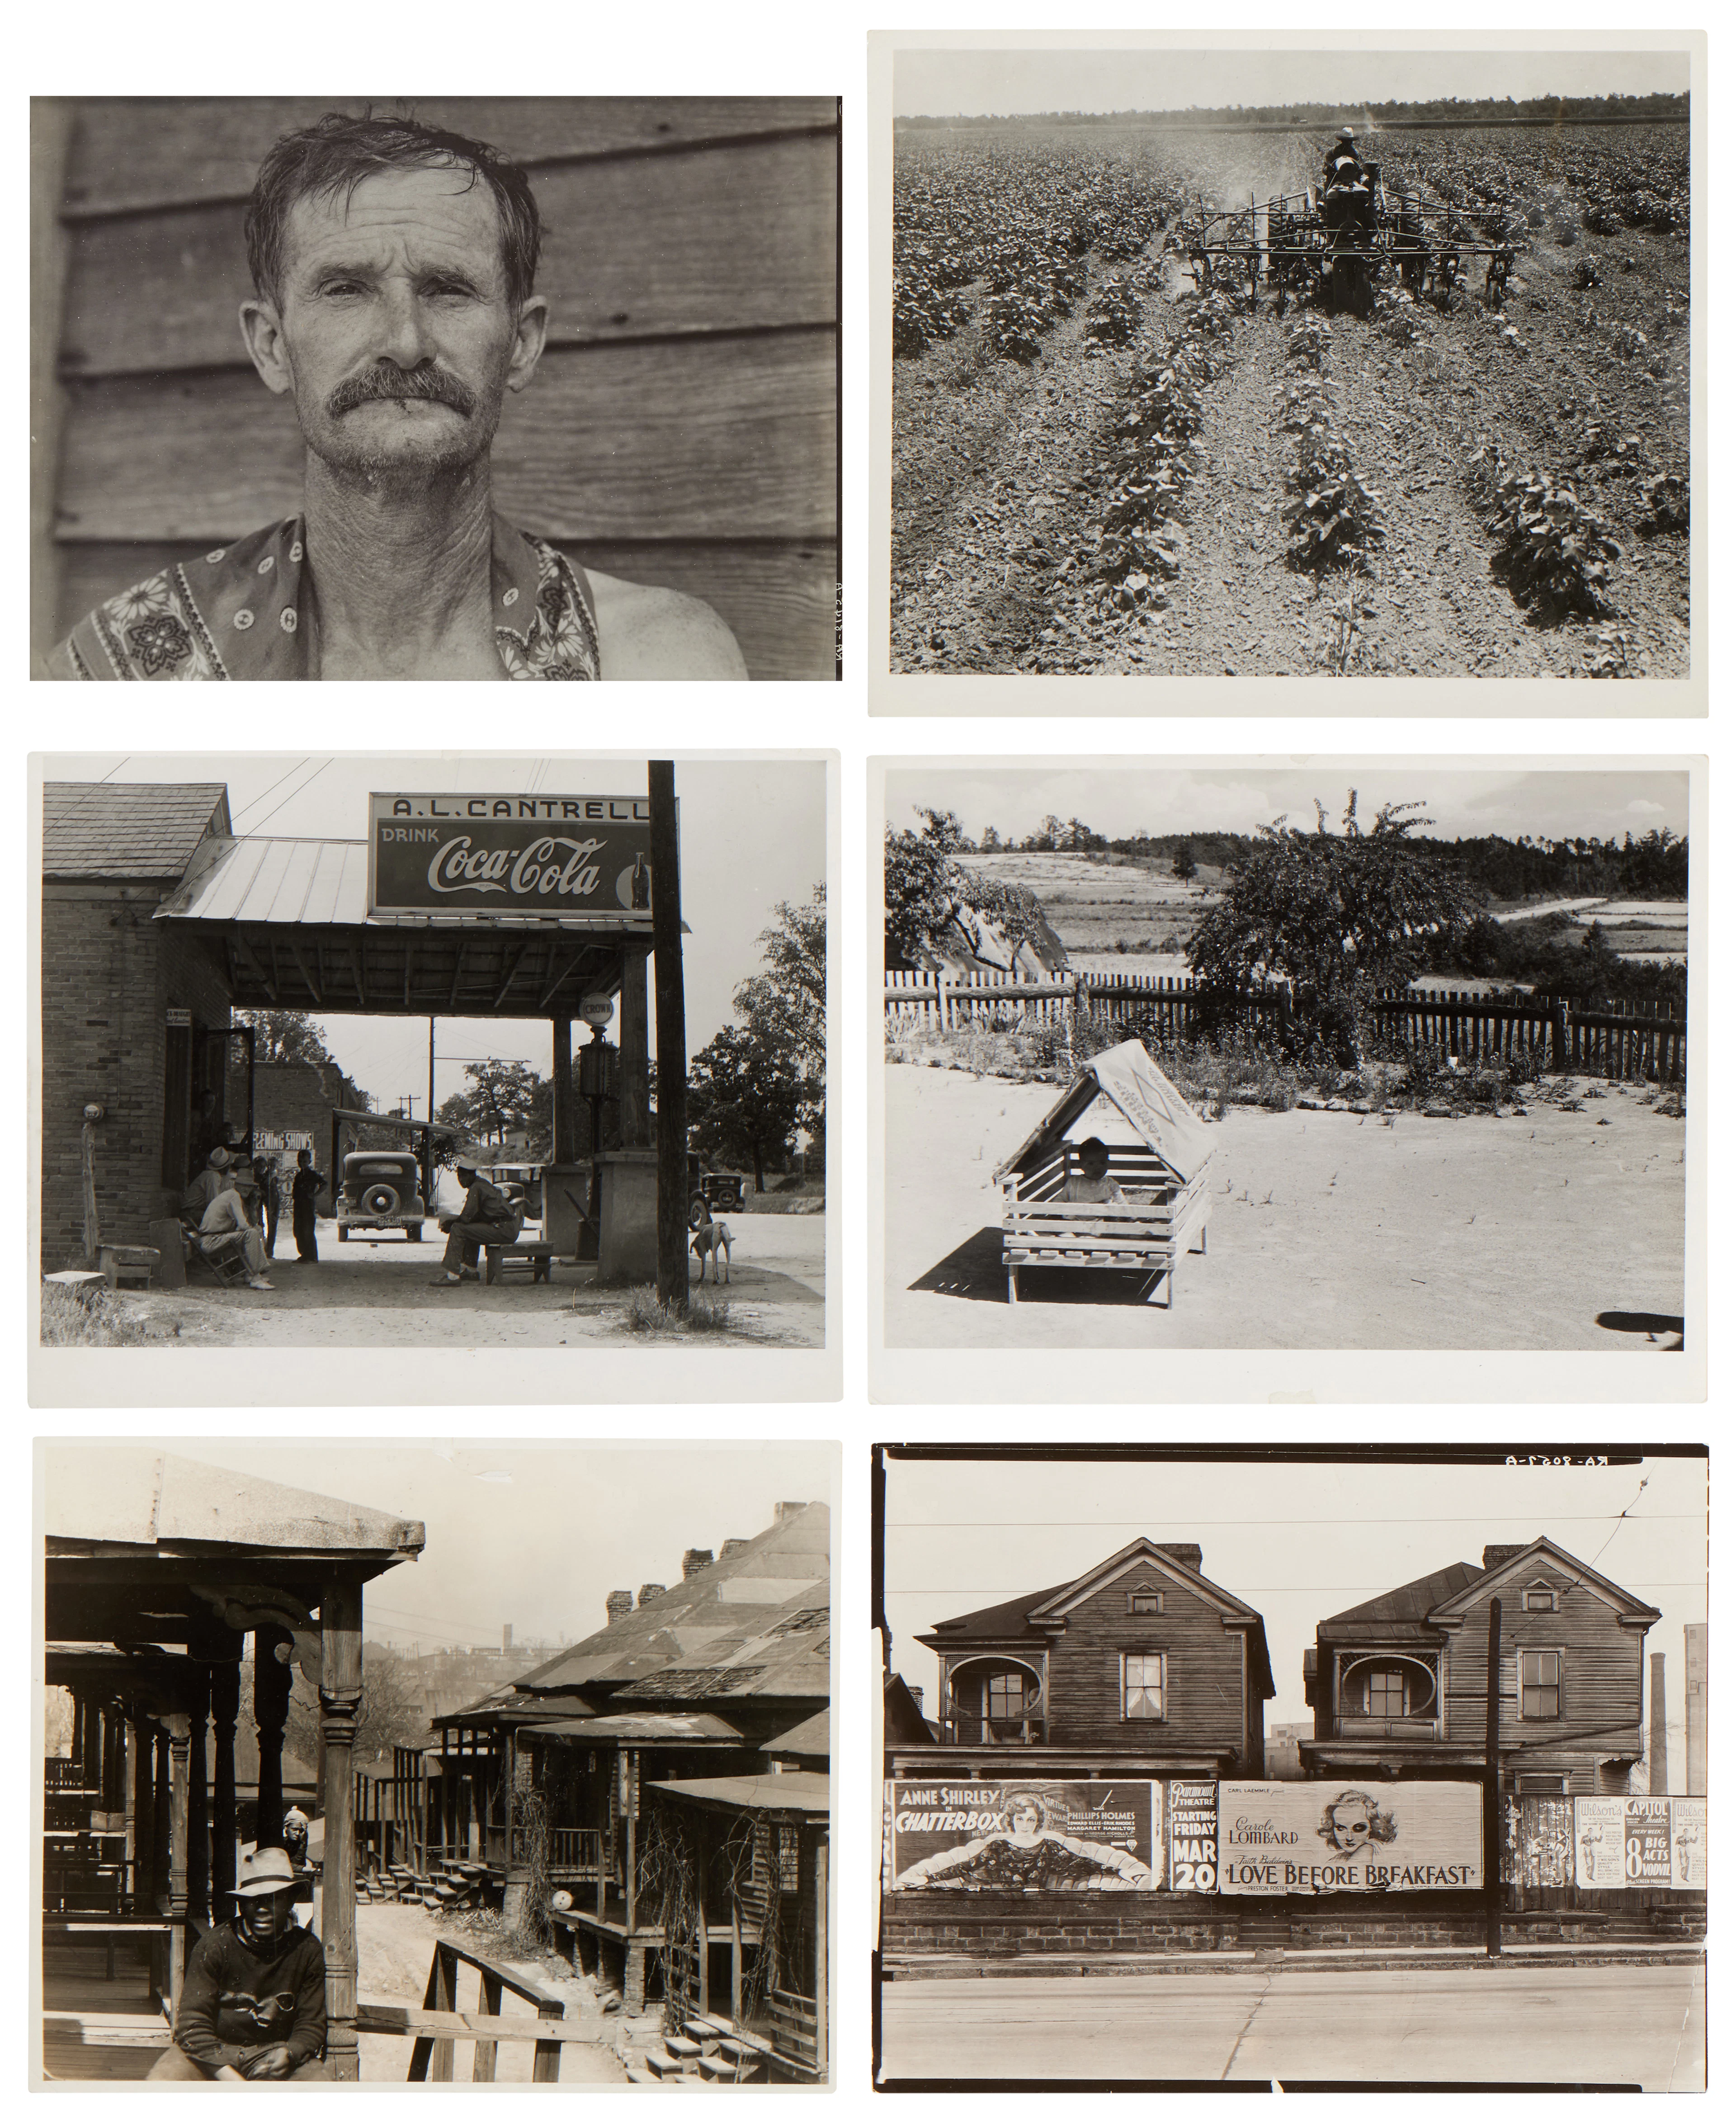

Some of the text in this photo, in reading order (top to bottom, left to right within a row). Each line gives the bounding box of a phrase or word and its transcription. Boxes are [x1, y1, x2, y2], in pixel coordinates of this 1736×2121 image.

[382, 828, 439, 842] DRINK
[428, 836, 608, 895] Coca-Cola
[585, 1003, 611, 1014] CROWN
[286, 1133, 311, 1149] SHOWS
[900, 1787, 1000, 1805] ANNE SHIRLEY
[1043, 1794, 1070, 1812] VIRTUES
[1172, 1783, 1217, 1807] Paramount
[1581, 1804, 1622, 1816] Wilson's
[1625, 1799, 1668, 1815] CAPITOL
[896, 1811, 1005, 1833] CHATTERBOX
[1173, 1811, 1217, 1821] STARTING
[1236, 1816, 1274, 1832] Carole
[1643, 1814, 1670, 1823] Theatre
[1175, 1823, 1216, 1835] FRIDAY
[1229, 1830, 1298, 1844] LOMBARD
[1174, 1839, 1217, 1862] MAR
[1626, 1837, 1668, 1878] 8 BIG
[1643, 1849, 1669, 1861] ACTS
[1235, 1854, 1293, 1865] Faith Baldwin's
[1176, 1863, 1215, 1890] 20
[1285, 1865, 1359, 1885] BEFORE
[1642, 1863, 1671, 1876] VODVIL
